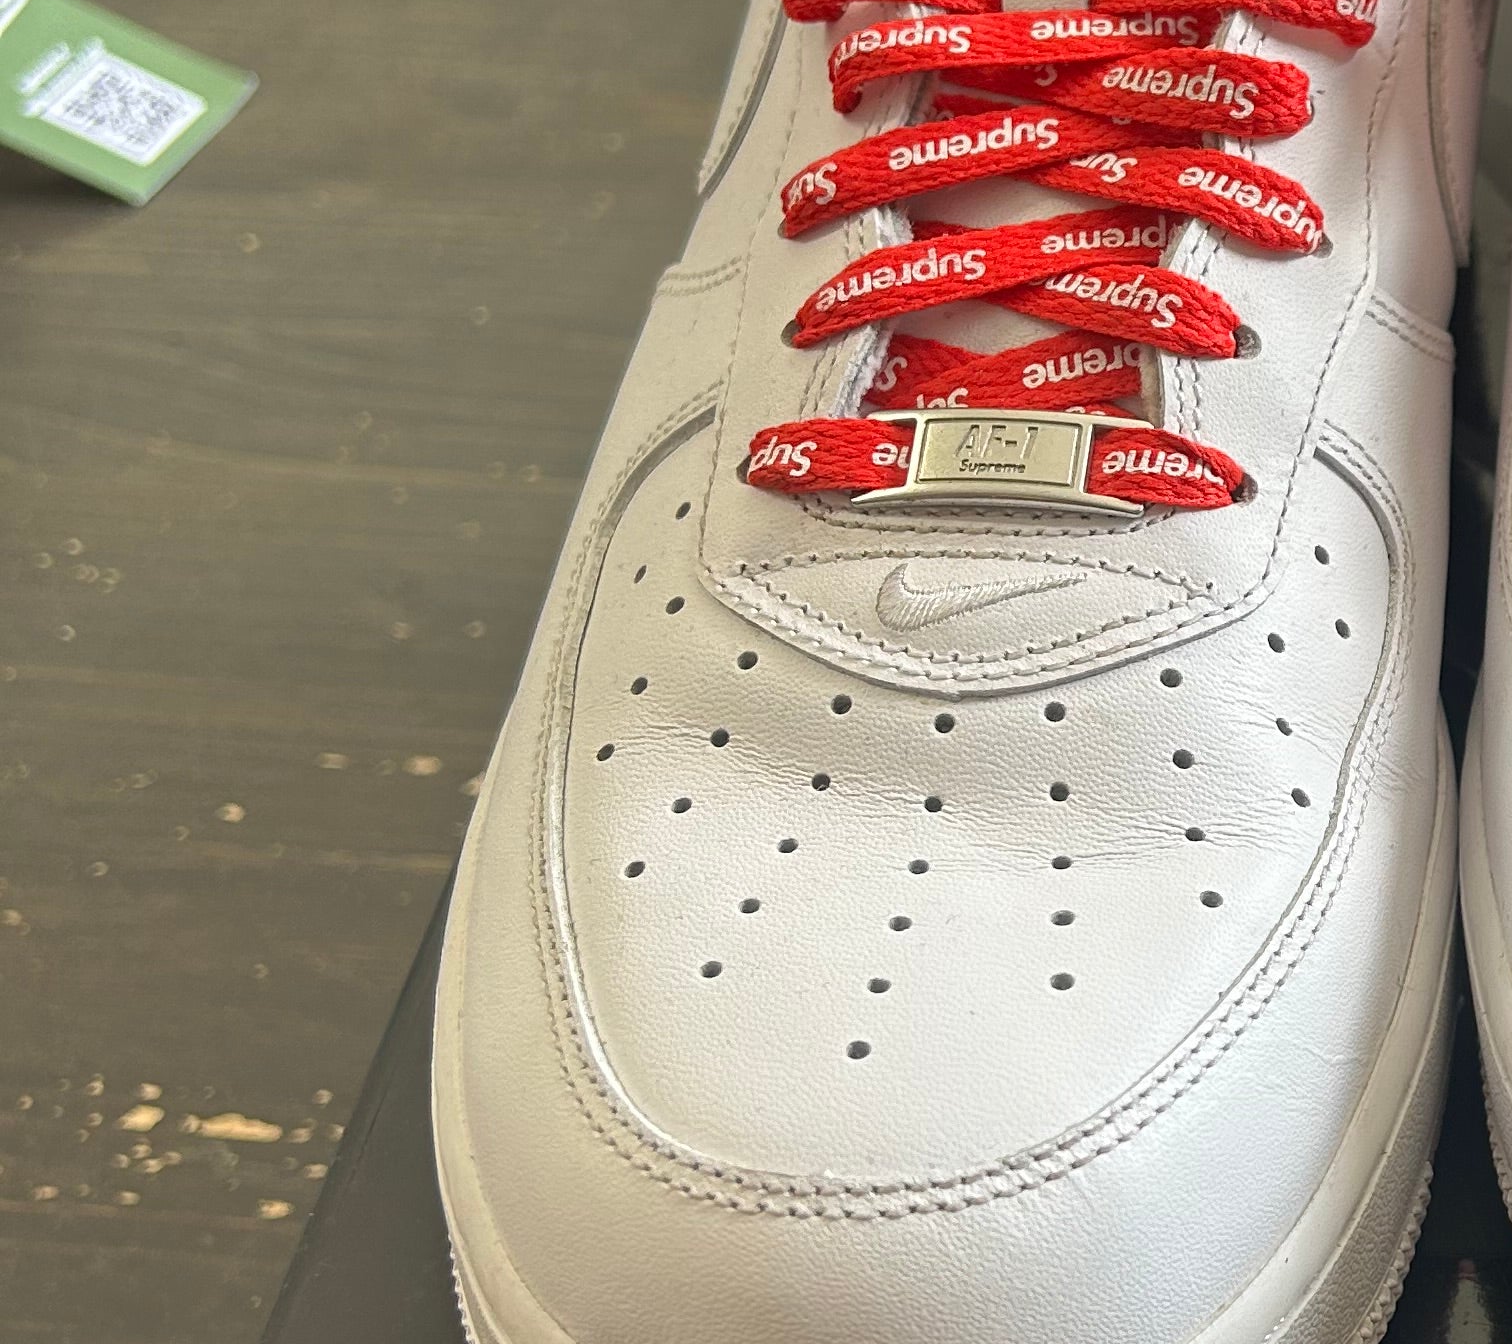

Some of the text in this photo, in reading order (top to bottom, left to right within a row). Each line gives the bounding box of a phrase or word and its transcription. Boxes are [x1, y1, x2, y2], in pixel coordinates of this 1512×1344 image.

[1030, 16, 1199, 46] Supreme
[1101, 63, 1259, 120] Supreme
[887, 116, 1060, 171] Supreme
[816, 247, 987, 313] Supreme
[958, 458, 1027, 476] Supreme
